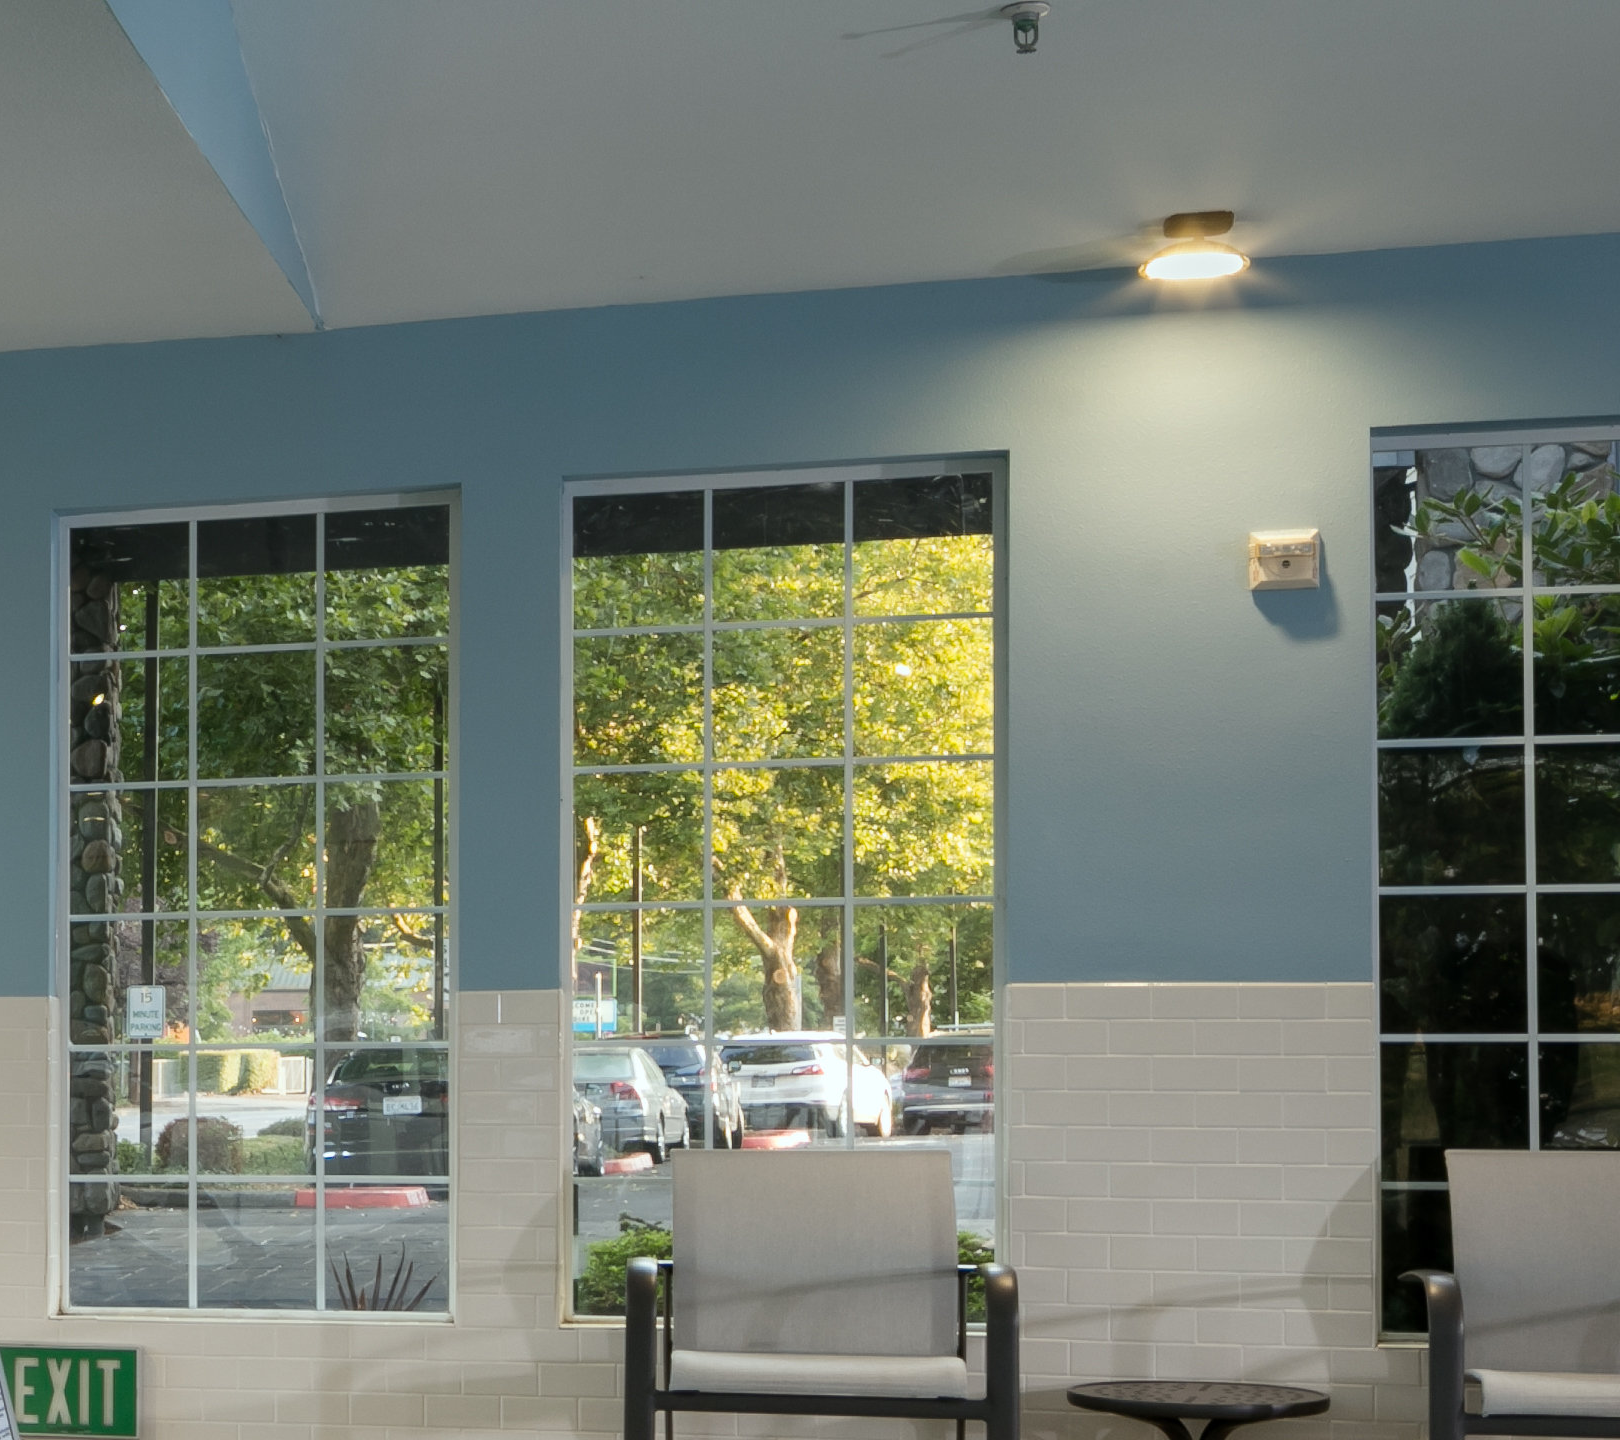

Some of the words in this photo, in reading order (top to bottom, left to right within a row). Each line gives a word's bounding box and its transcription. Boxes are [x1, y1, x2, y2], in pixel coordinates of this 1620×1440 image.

[140, 992, 153, 1003] 15
[132, 1010, 159, 1019] MINUTE
[130, 1023, 161, 1031] PARKING
[15, 1357, 121, 1427] EXIT
